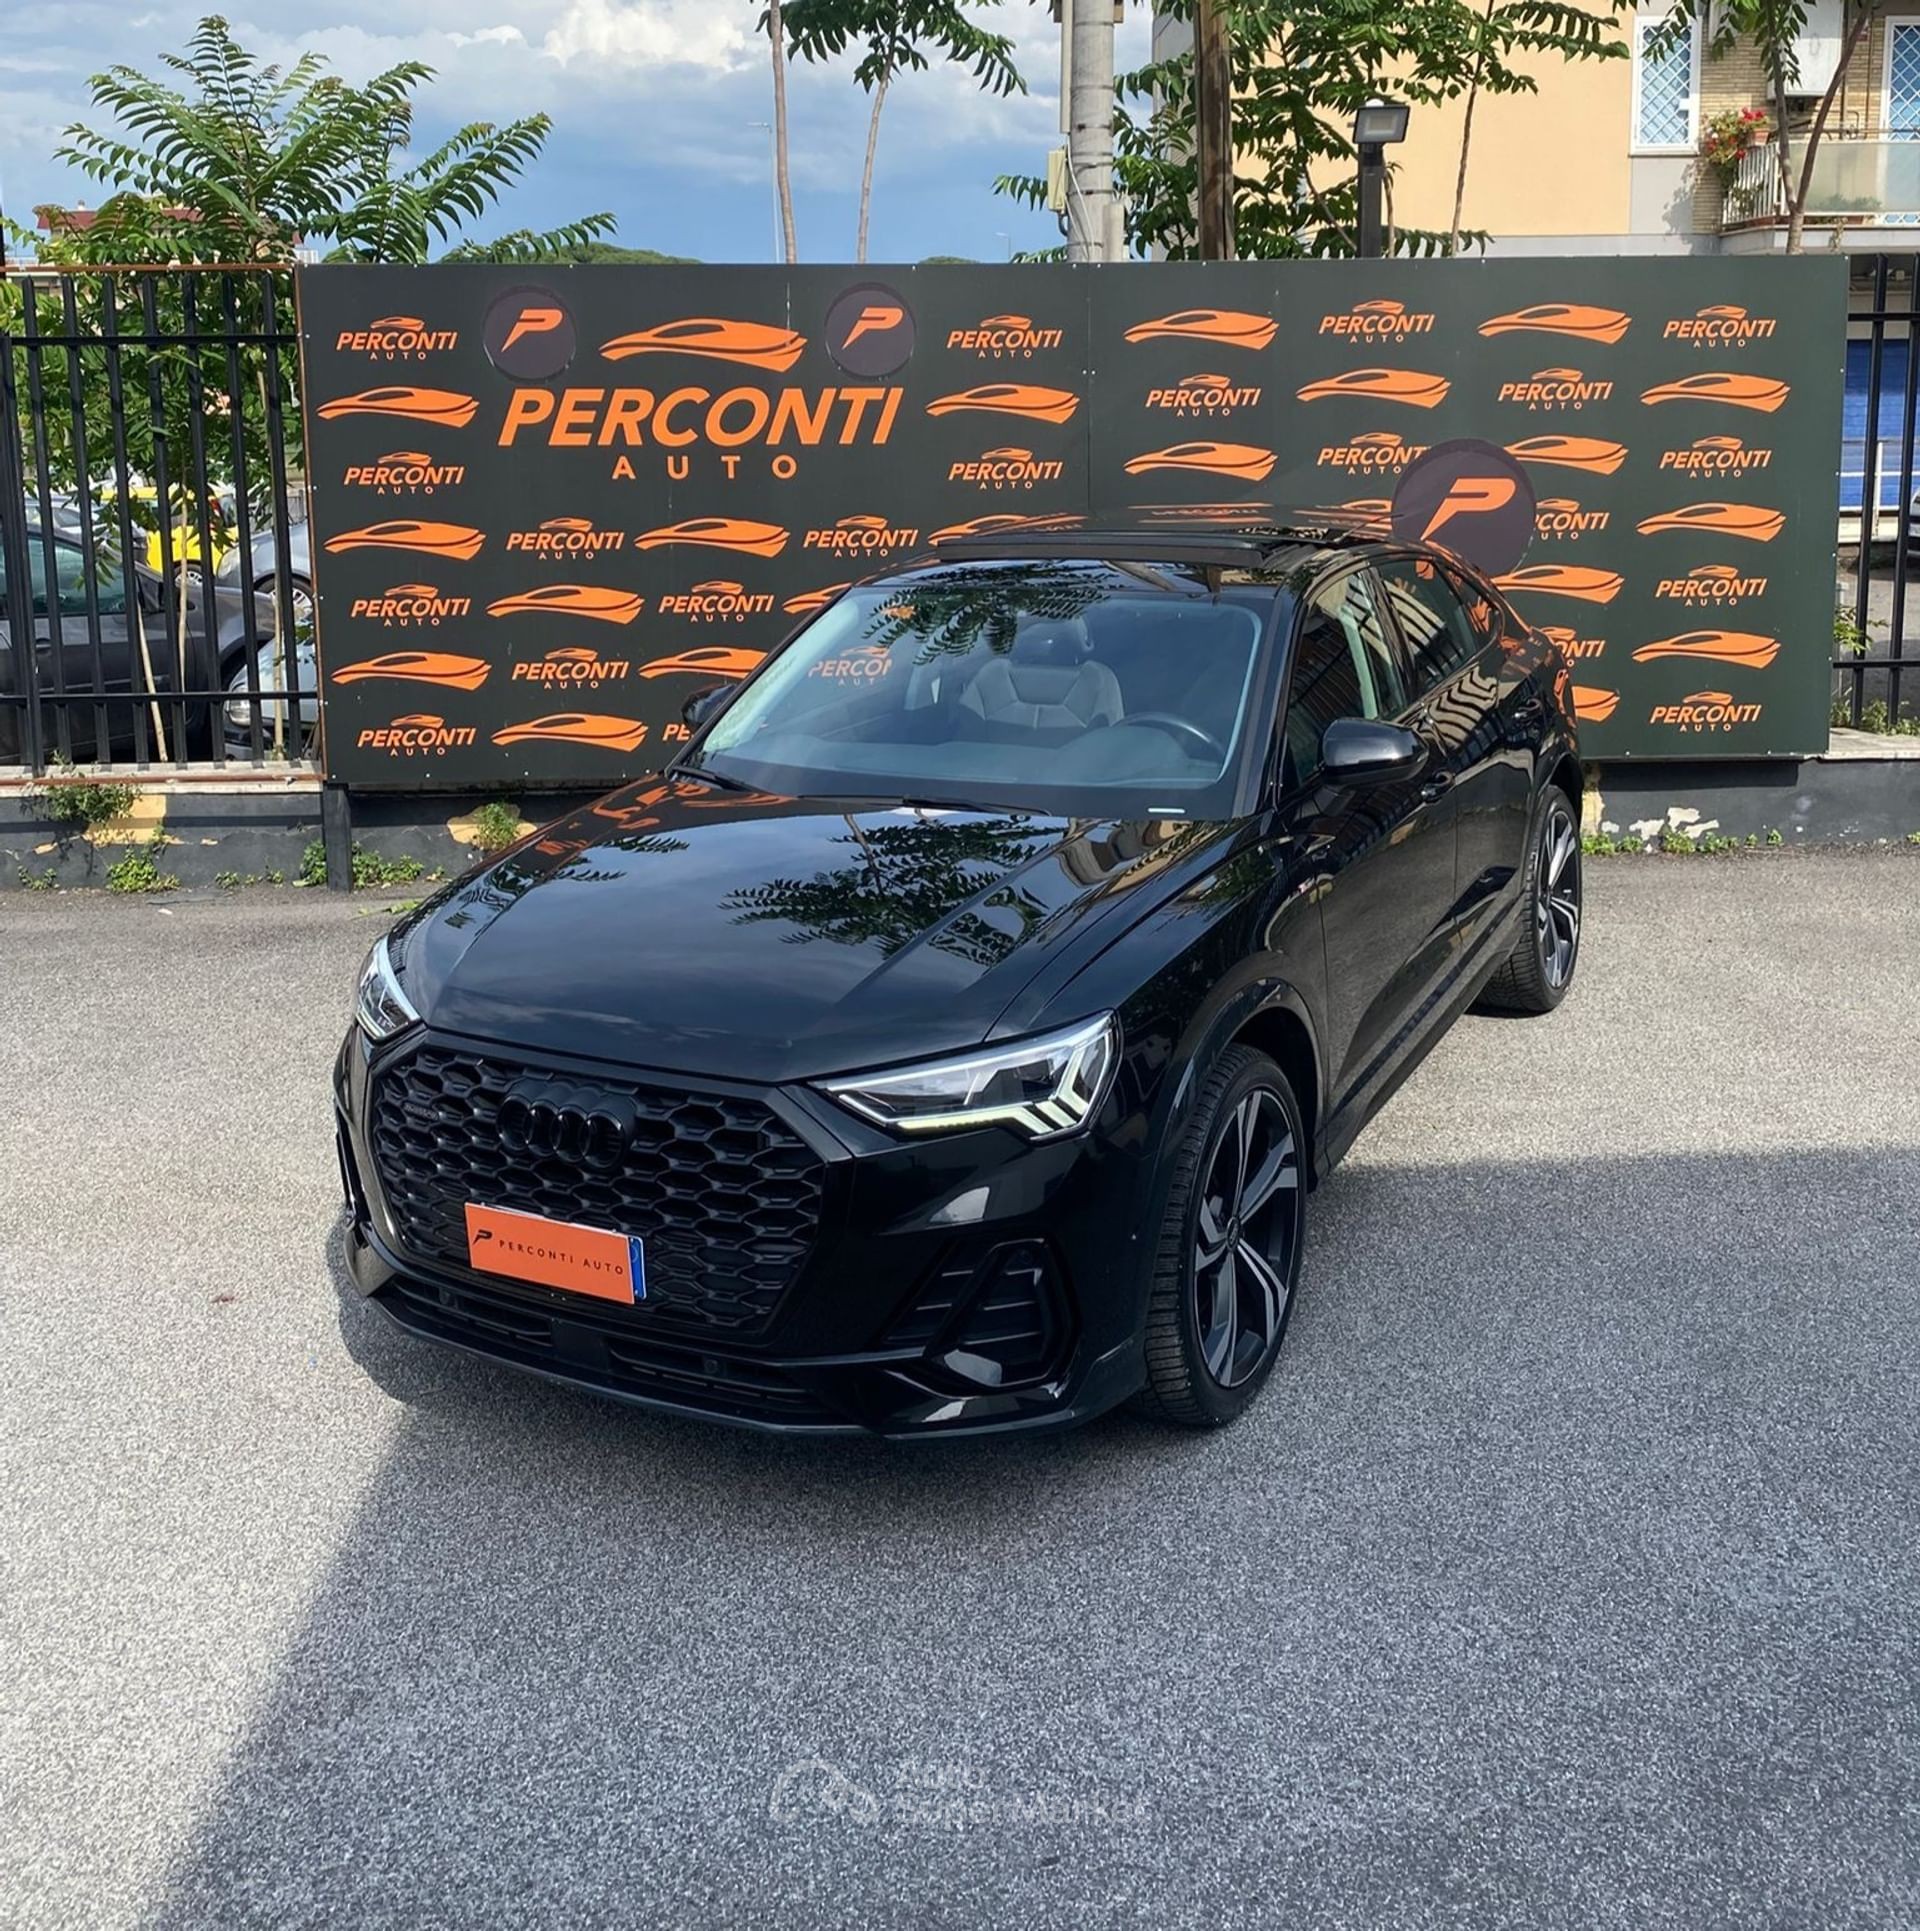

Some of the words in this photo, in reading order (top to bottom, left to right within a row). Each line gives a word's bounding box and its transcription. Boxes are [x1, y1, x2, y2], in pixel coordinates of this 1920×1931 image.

[1319, 315, 1434, 334] PERCONTI
[1664, 320, 1776, 338] PERCONTI
[337, 332, 457, 350] PERCONTI
[947, 330, 1062, 348] PERCONTI
[1350, 334, 1404, 343] AUTO
[1694, 338, 1746, 347] AUTO
[371, 351, 427, 360] AUTO
[979, 349, 1032, 358] AUTO
[1146, 388, 1261, 407] PERCONTI
[1498, 382, 1613, 401] PERCONTI
[1177, 407, 1231, 416] AUTO
[1529, 401, 1582, 410] AUTO
[498, 387, 904, 447] PERCONTI
[1317, 446, 1431, 465] PERCONT
[1660, 450, 1771, 469] PERCONTI
[344, 467, 464, 485] PERCONTI
[612, 455, 798, 480] AUTO
[949, 462, 1063, 480] PERCONTI
[1348, 465, 1402, 475] AUTO
[1690, 469, 1742, 478] AUTO
[378, 485, 433, 494] AUTO
[980, 481, 1033, 489] AUTO
[507, 532, 624, 550] PERCONTI
[803, 530, 918, 547] PERCONTI
[1540, 531, 1579, 540] UTO
[539, 550, 594, 559] AUTO
[835, 549, 888, 557] AUTO
[1656, 579, 1767, 597] PERCONTI
[351, 599, 470, 617] PERCONTI
[659, 595, 774, 613] PERCONTI
[1685, 597, 1737, 606] AUTO
[384, 618, 440, 626] AUTO
[691, 614, 744, 622] AUTO
[512, 662, 629, 680] PERCONTI
[544, 680, 599, 689] AUTO
[1650, 705, 1761, 723] PERCONTI
[1680, 723, 1732, 732] AUTO
[357, 728, 476, 747] PERCONTI
[391, 747, 445, 756] AUTO
[499, 1239, 574, 1264] PERCONTI
[583, 1258, 623, 1275] AUTO
